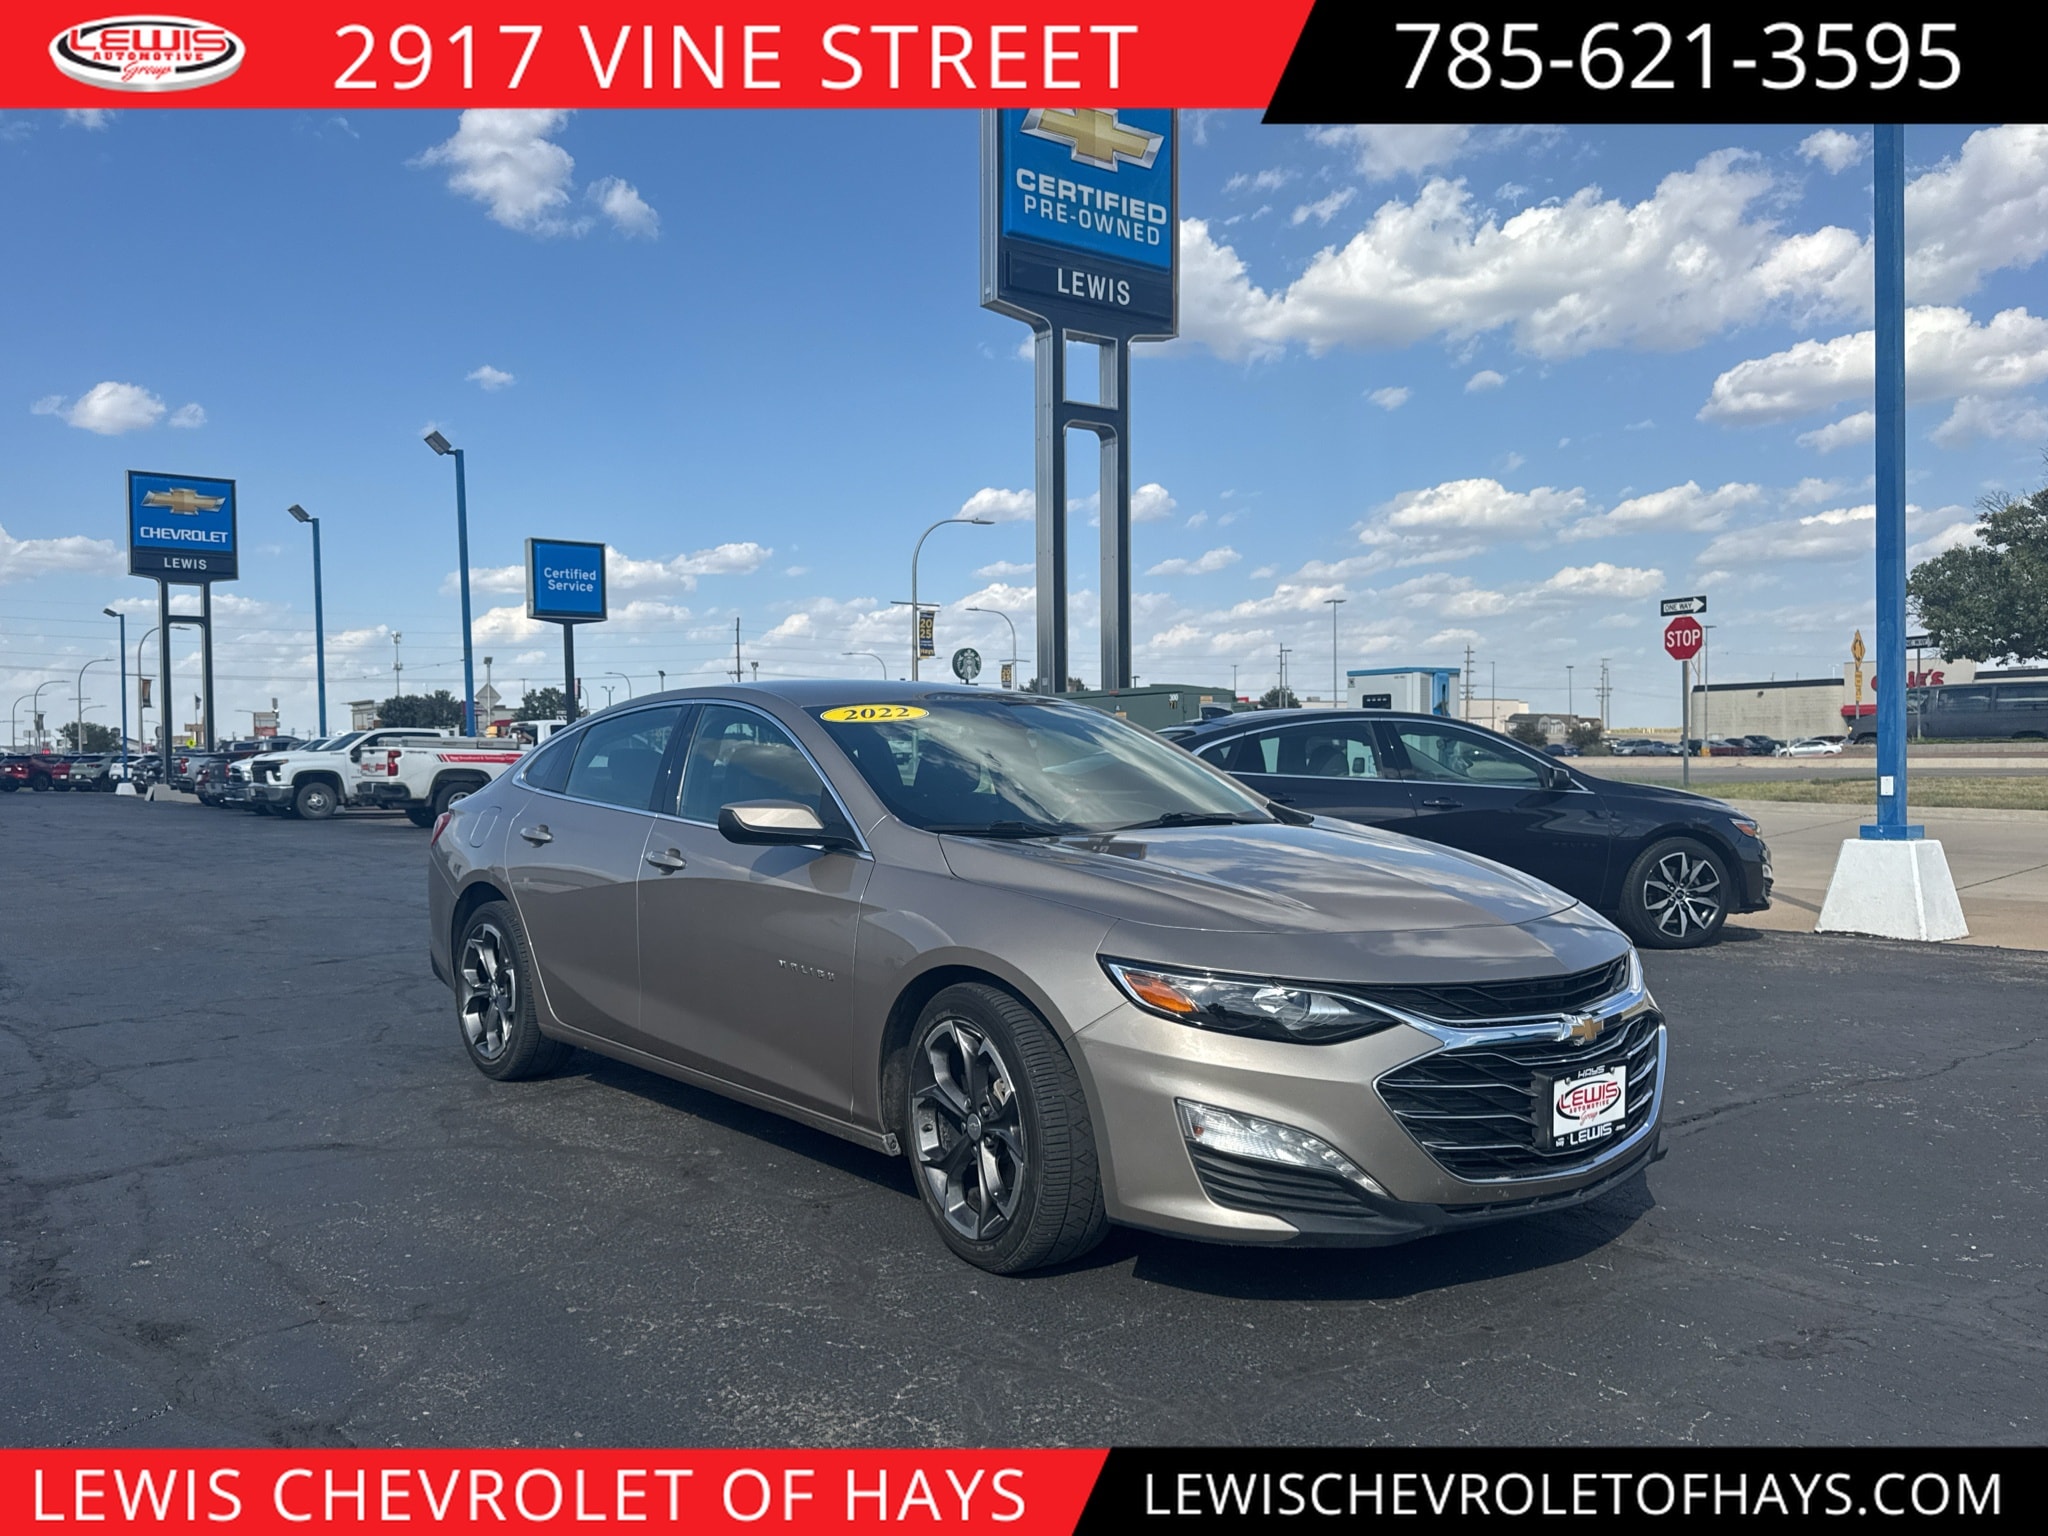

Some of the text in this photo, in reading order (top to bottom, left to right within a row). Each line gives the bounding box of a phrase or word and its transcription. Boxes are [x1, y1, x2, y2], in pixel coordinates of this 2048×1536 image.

[1016, 168, 1167, 225] CERTIFIED
[1024, 194, 1160, 246] PRE-OWNED
[1057, 267, 1131, 306] LEWIS
[140, 526, 228, 543] CHEVROLET
[164, 557, 207, 570] LEWIS
[544, 567, 596, 580] Certified
[548, 579, 594, 592] Service
[1679, 602, 1692, 610] WAY
[920, 618, 933, 629] 20
[920, 629, 932, 639] 25
[1666, 629, 1701, 648] STOP
[843, 707, 910, 720] 2022
[1577, 1065, 1606, 1079] HAYS
[1560, 1081, 1618, 1110] LEWIS
[1569, 1122, 1613, 1146] LEWIS
